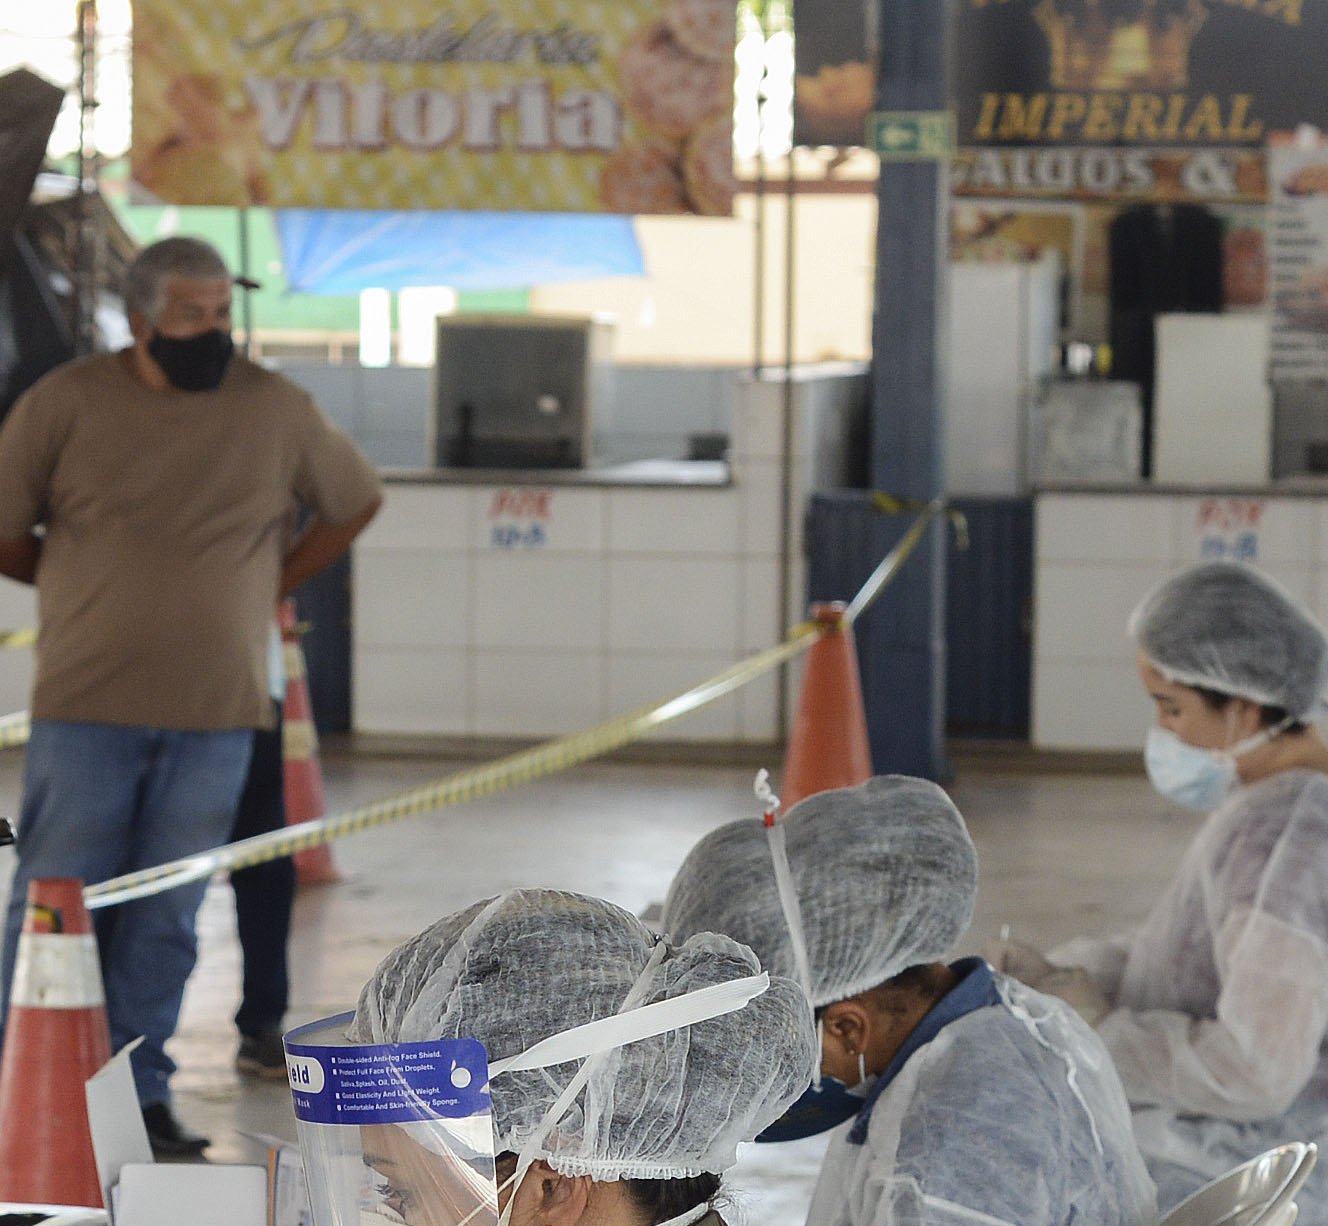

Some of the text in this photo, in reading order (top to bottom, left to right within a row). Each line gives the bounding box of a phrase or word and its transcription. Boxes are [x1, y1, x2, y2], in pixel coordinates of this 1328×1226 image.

[975, 93, 1264, 140] IMPERIAL
[288, 1061, 311, 1085] eld
[369, 1067, 384, 1075] Face
[355, 1091, 382, 1100] Elasticity
[383, 1090, 396, 1098] And
